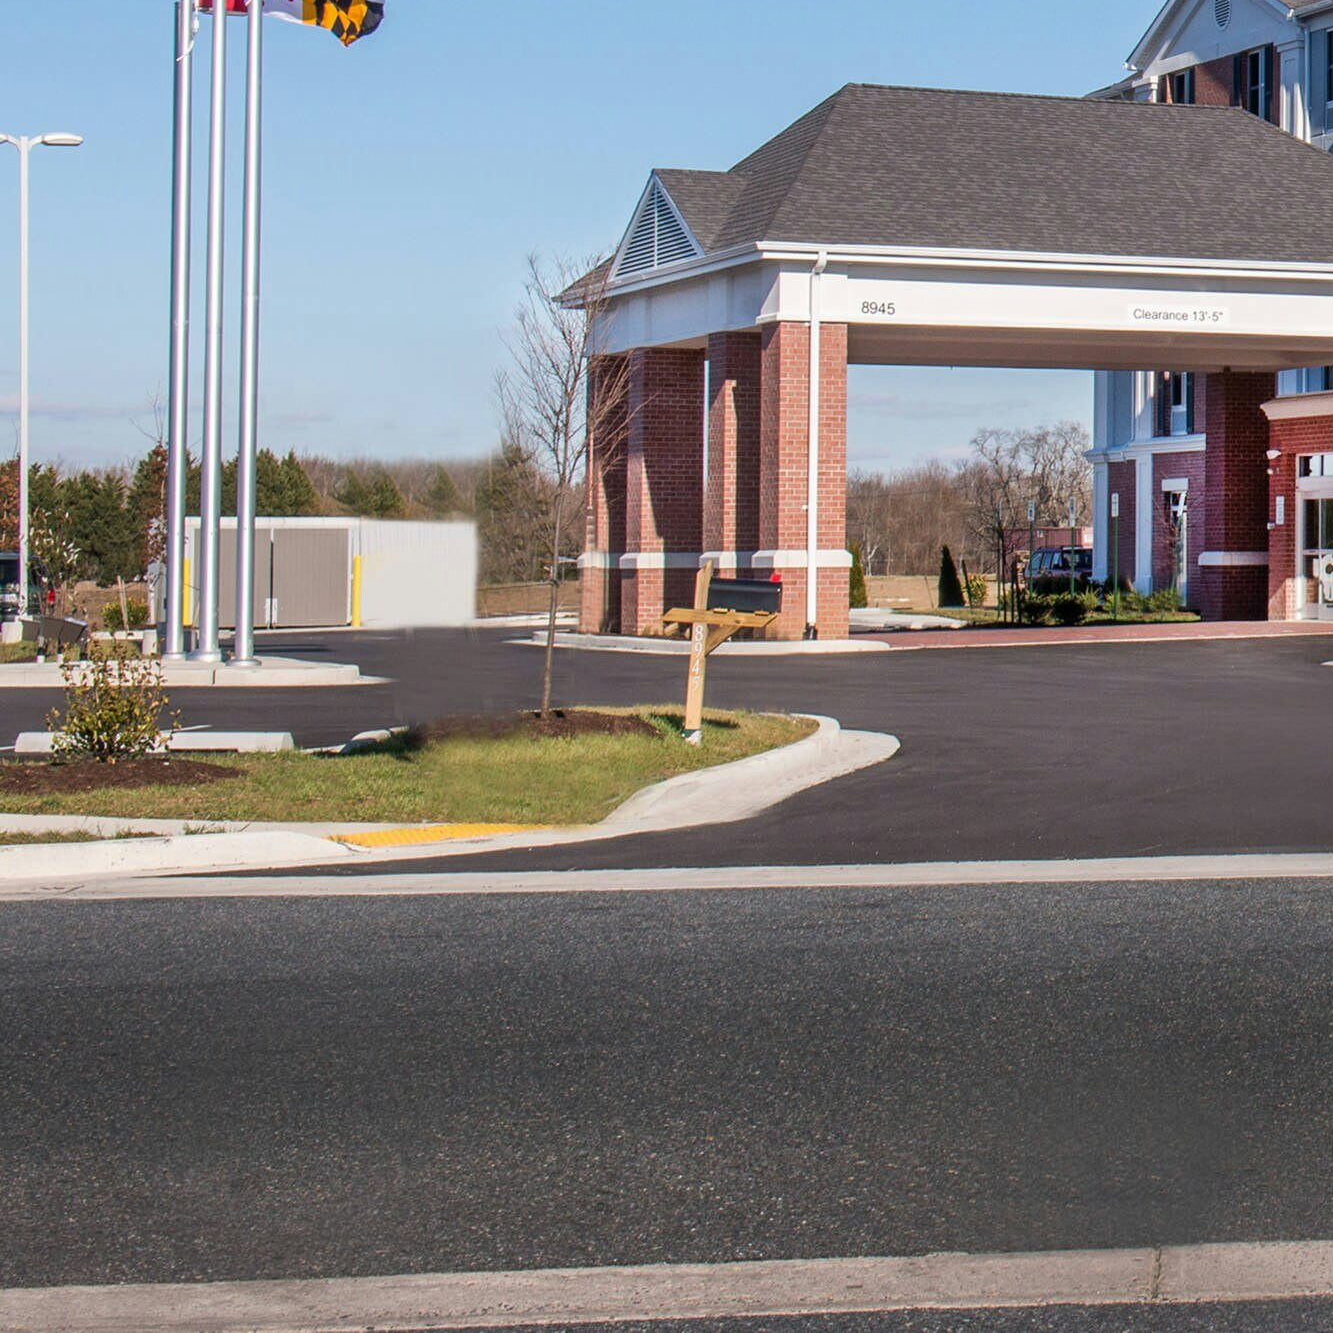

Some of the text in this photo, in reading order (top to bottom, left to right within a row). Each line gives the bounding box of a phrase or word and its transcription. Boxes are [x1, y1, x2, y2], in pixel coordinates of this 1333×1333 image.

[861, 300, 896, 316] 8945
[1133, 307, 1189, 322] Clearance
[692, 625, 704, 690] 8945
